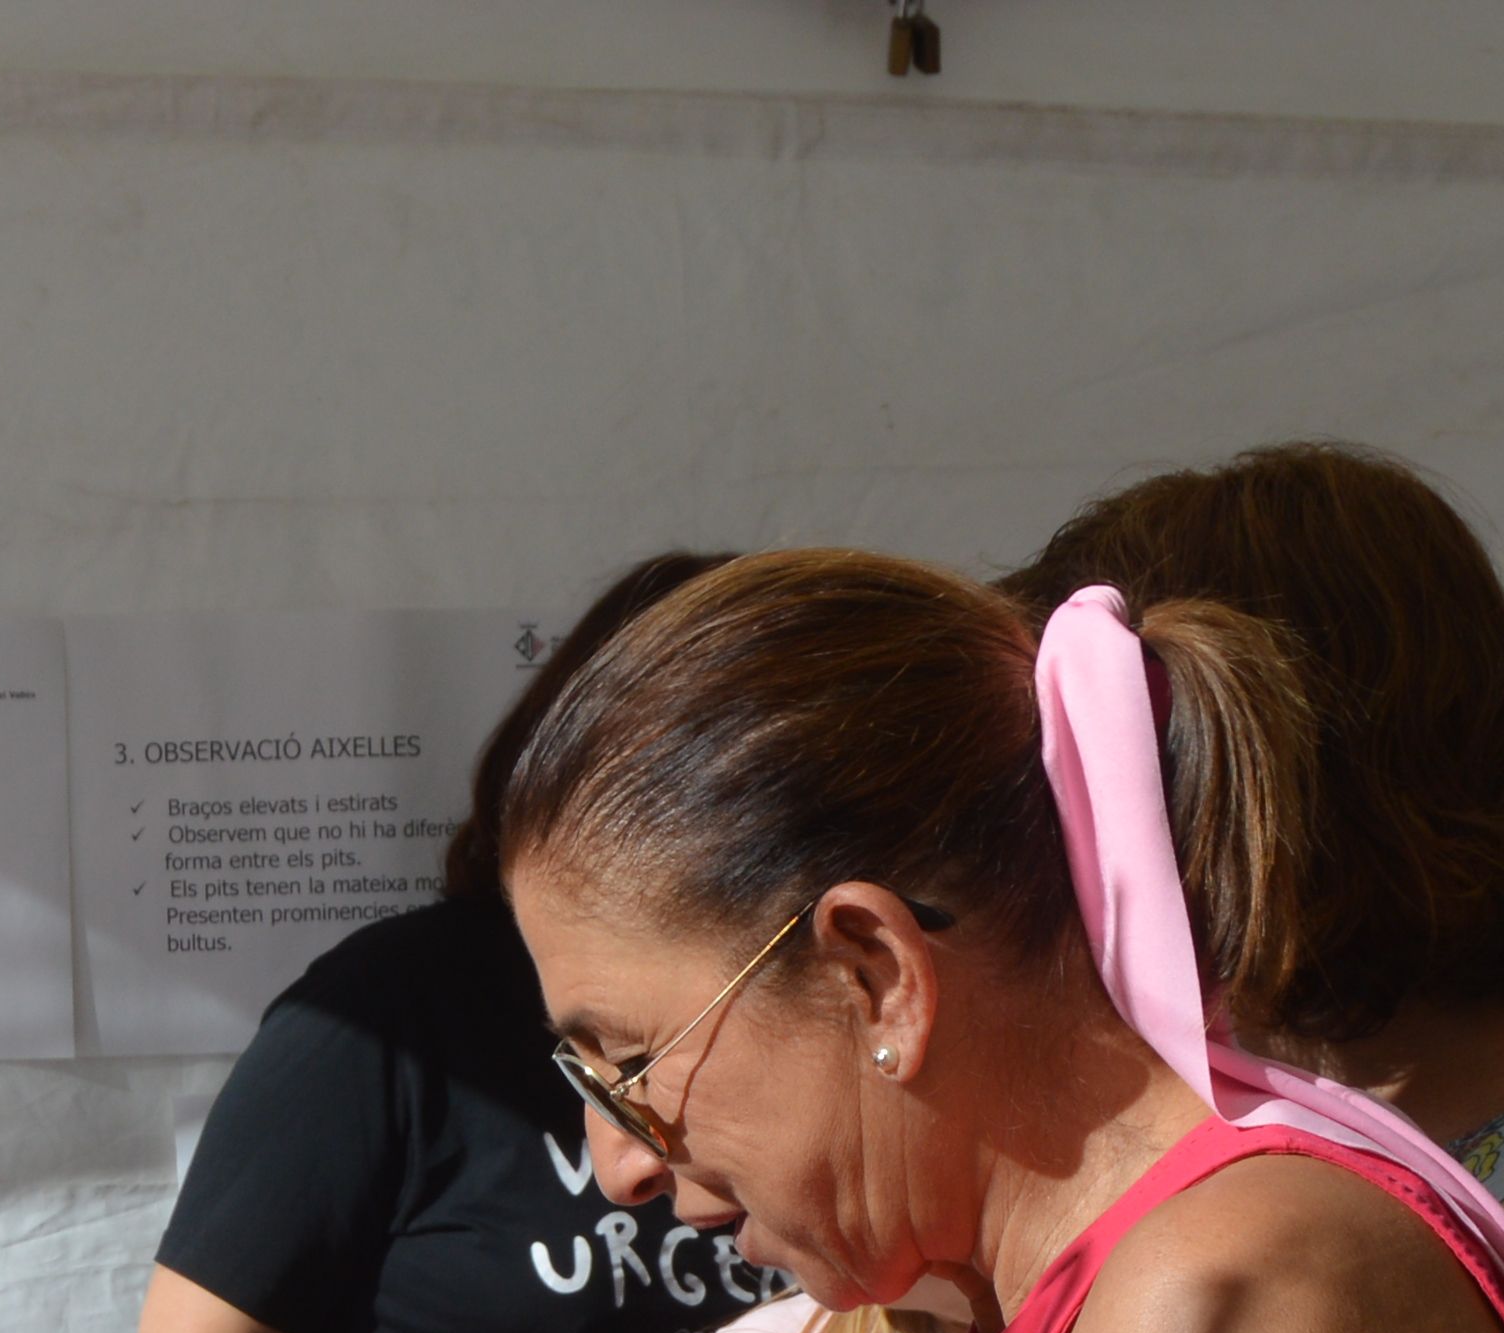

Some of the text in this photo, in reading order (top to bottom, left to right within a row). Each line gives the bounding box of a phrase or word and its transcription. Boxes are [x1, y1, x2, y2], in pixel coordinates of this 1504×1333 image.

[114, 732, 422, 764] 3. OBSERVACIÓ AIXELLES
[168, 794, 399, 819] Braços elevats i estirats
[168, 825, 267, 844] Observem
[273, 826, 311, 849] que
[318, 824, 342, 840] no
[348, 821, 367, 838] hi
[373, 821, 397, 838] ha
[165, 848, 362, 873] forma entre els pits.
[170, 879, 197, 898] Els
[204, 878, 240, 901] pits
[246, 878, 302, 896] tenen
[308, 876, 326, 894] la
[332, 875, 408, 894] mateixa
[166, 902, 400, 927] Presenten prominencies
[167, 932, 233, 952] bultus.
